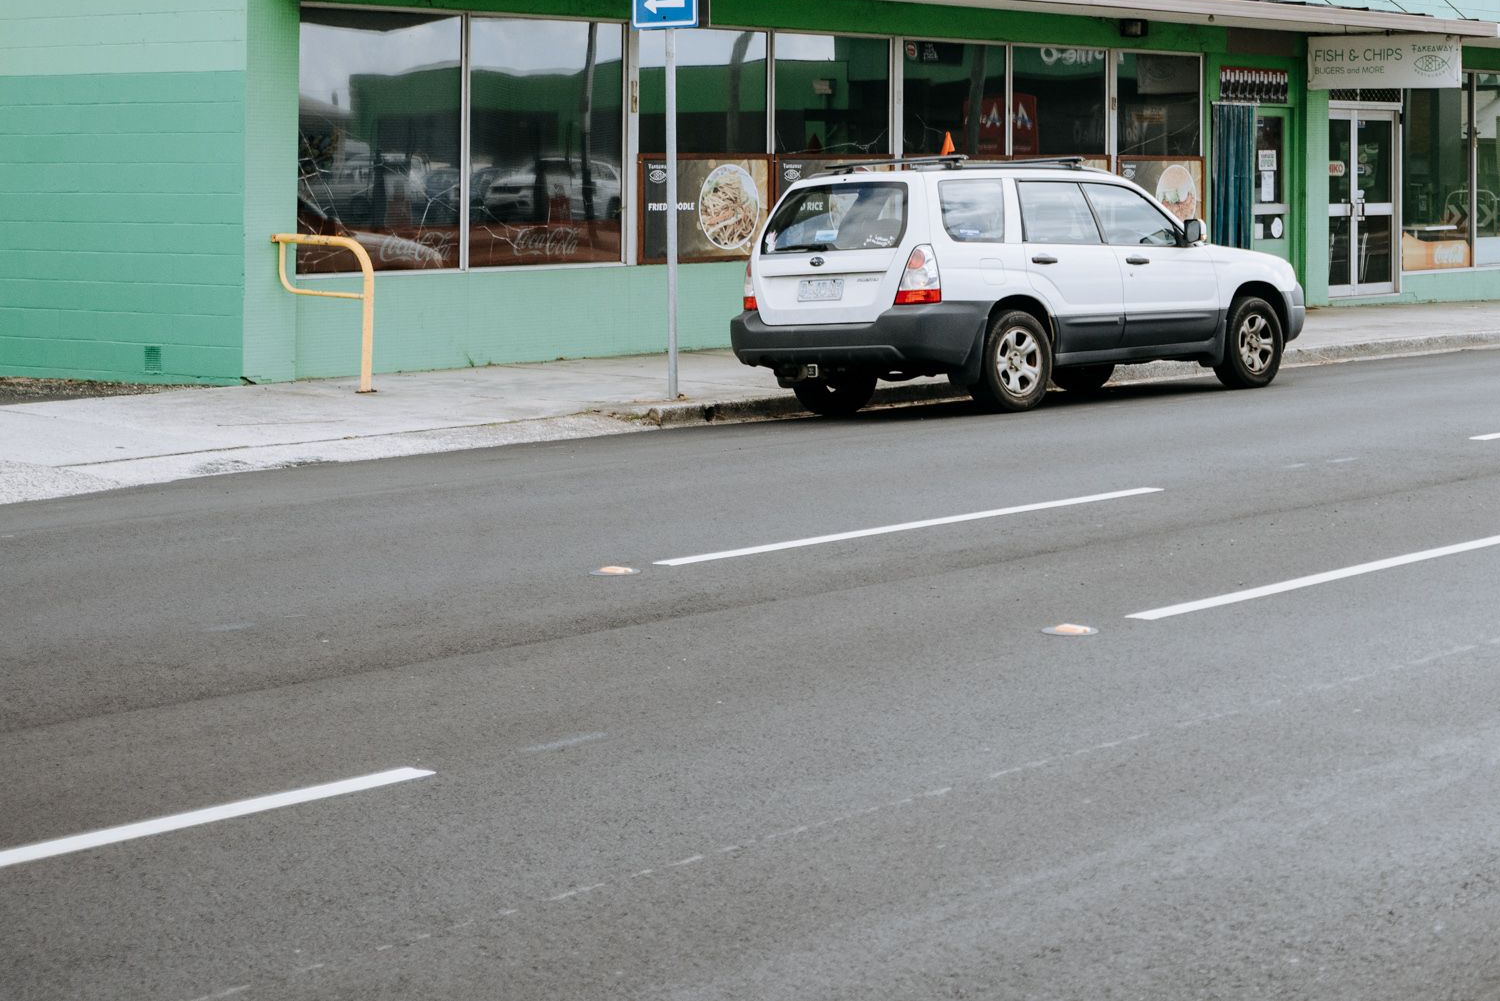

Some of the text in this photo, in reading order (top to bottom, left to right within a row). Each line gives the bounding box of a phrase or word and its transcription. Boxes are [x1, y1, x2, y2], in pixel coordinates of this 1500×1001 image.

[1411, 44, 1453, 53] TAKEAWAY
[1314, 48, 1403, 62] FISH & CHIPS
[1347, 66, 1360, 74] and
[1361, 65, 1385, 74] MORE
[648, 202, 667, 211] FRIED
[807, 201, 824, 211] RICE
